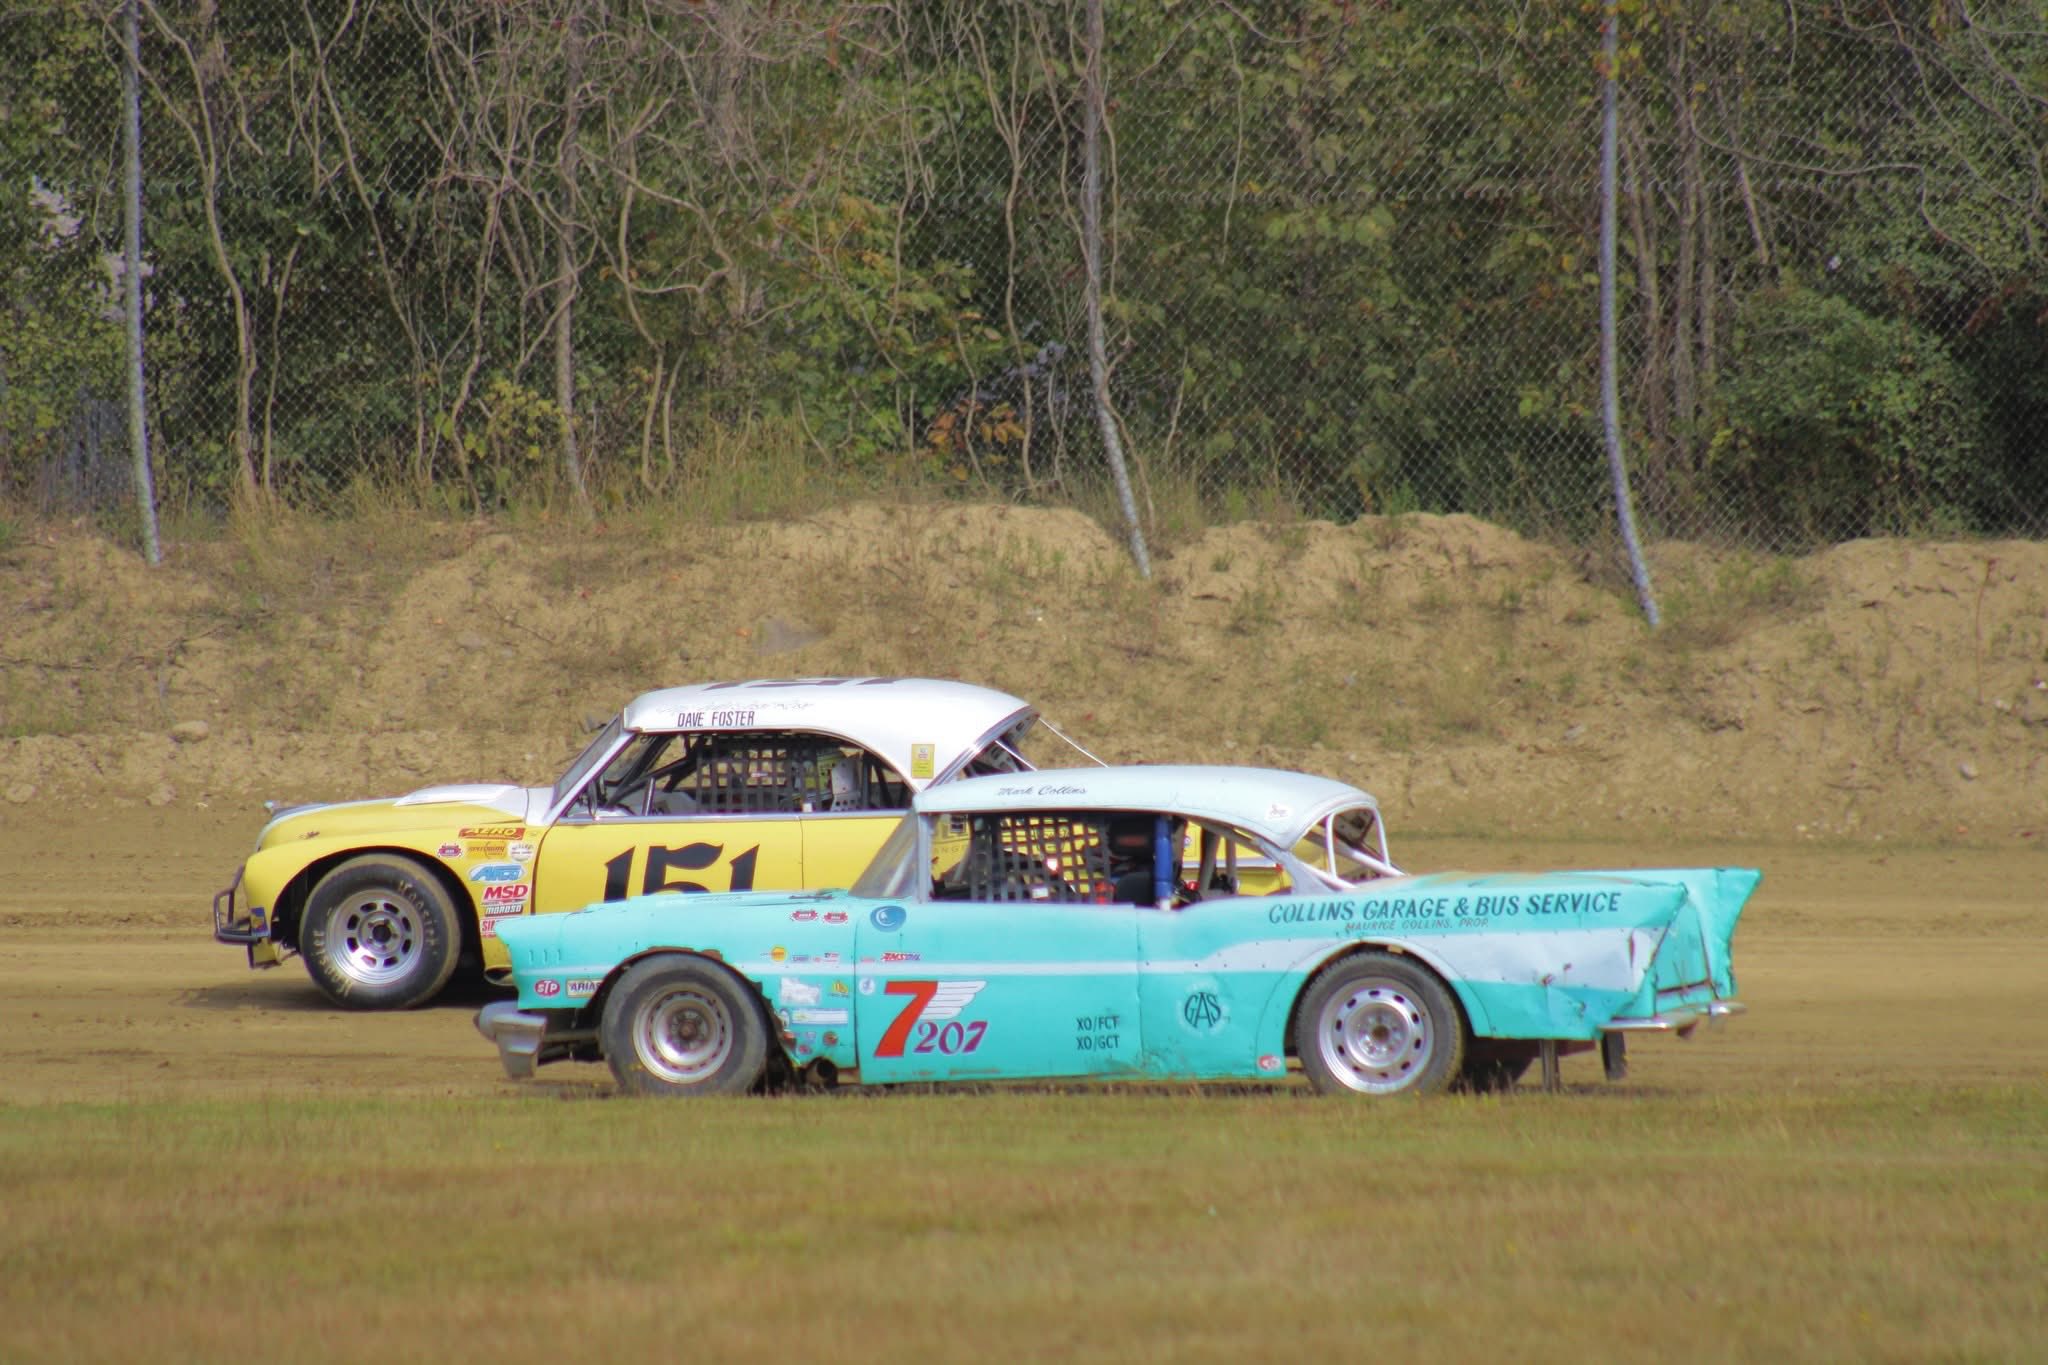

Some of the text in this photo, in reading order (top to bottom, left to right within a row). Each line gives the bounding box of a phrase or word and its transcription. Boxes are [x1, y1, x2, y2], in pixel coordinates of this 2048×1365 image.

[677, 710, 756, 727] DAVE FOSTER
[1037, 784, 1088, 796] Collins
[603, 842, 761, 903] 151
[483, 884, 529, 900] MSD
[1268, 891, 1622, 924] COLLINS GARAGE & BUS SERVICE
[1345, 919, 1397, 931] MAURICE
[537, 980, 558, 995] STP
[1184, 991, 1222, 1029] GAS
[873, 980, 939, 1058] 7
[1076, 1015, 1120, 1032] XO/FCT
[913, 1020, 989, 1055] 207
[1076, 1034, 1120, 1051] XO/GCT
